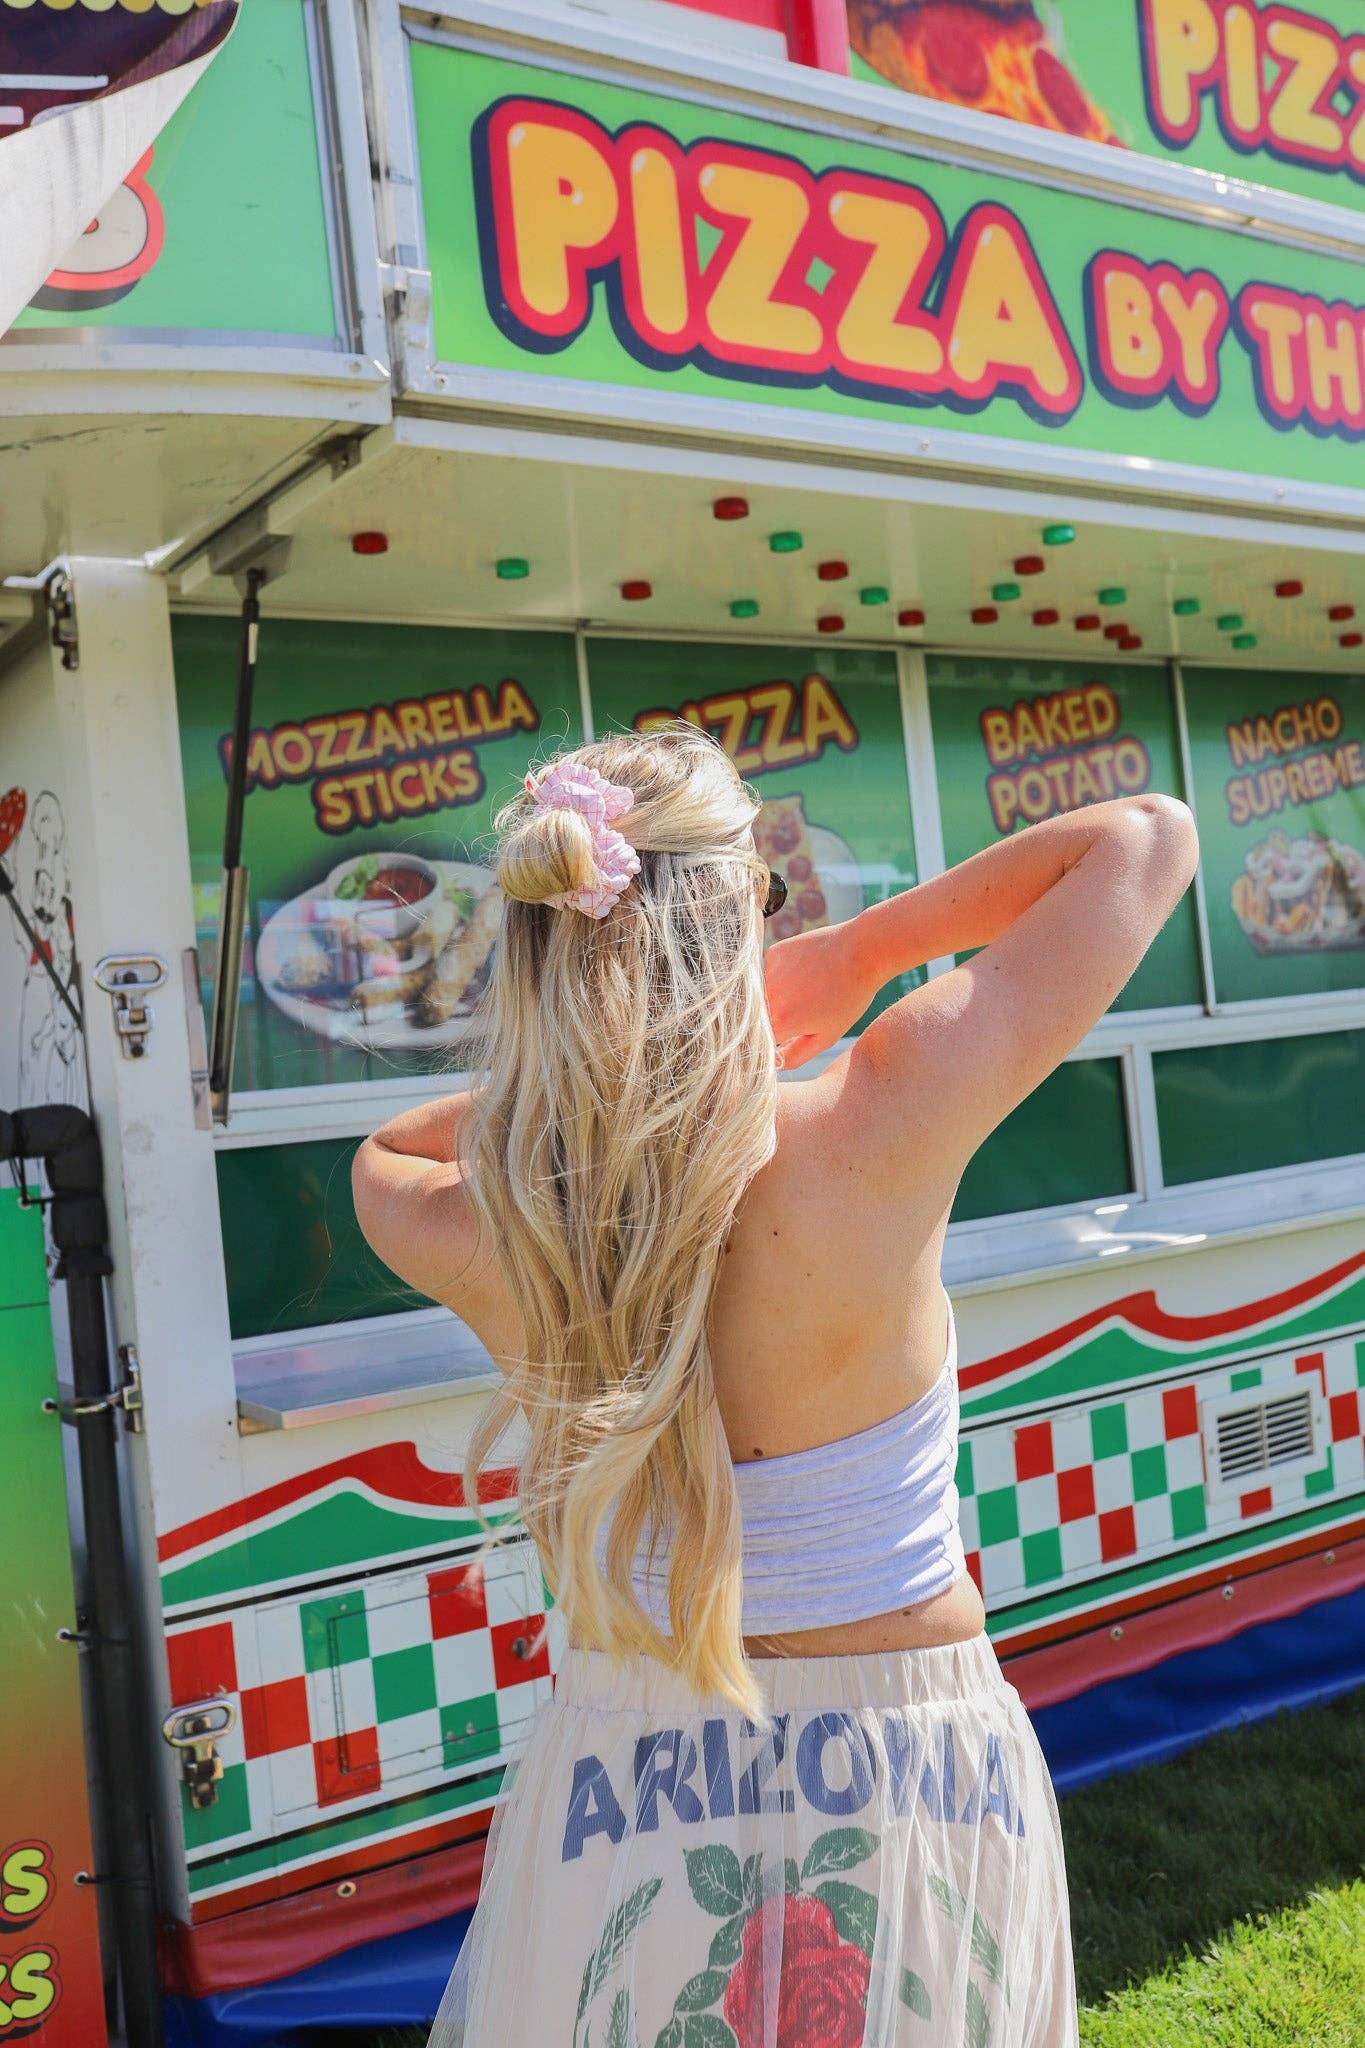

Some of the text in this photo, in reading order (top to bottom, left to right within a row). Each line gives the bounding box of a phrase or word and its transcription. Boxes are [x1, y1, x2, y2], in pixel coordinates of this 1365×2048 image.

[1144, 0, 1365, 166] PIZ
[490, 102, 1365, 430] PIZZA BY TH
[223, 682, 536, 785] MOZZARELLA
[637, 678, 857, 772] ZZA
[983, 685, 1117, 765] BAKED
[1228, 697, 1341, 767] NACHO
[317, 750, 482, 831] STICKS
[990, 739, 1149, 831] POTATO
[1227, 742, 1365, 824] SUPREME
[562, 1712, 1026, 1863] ARIZONA
